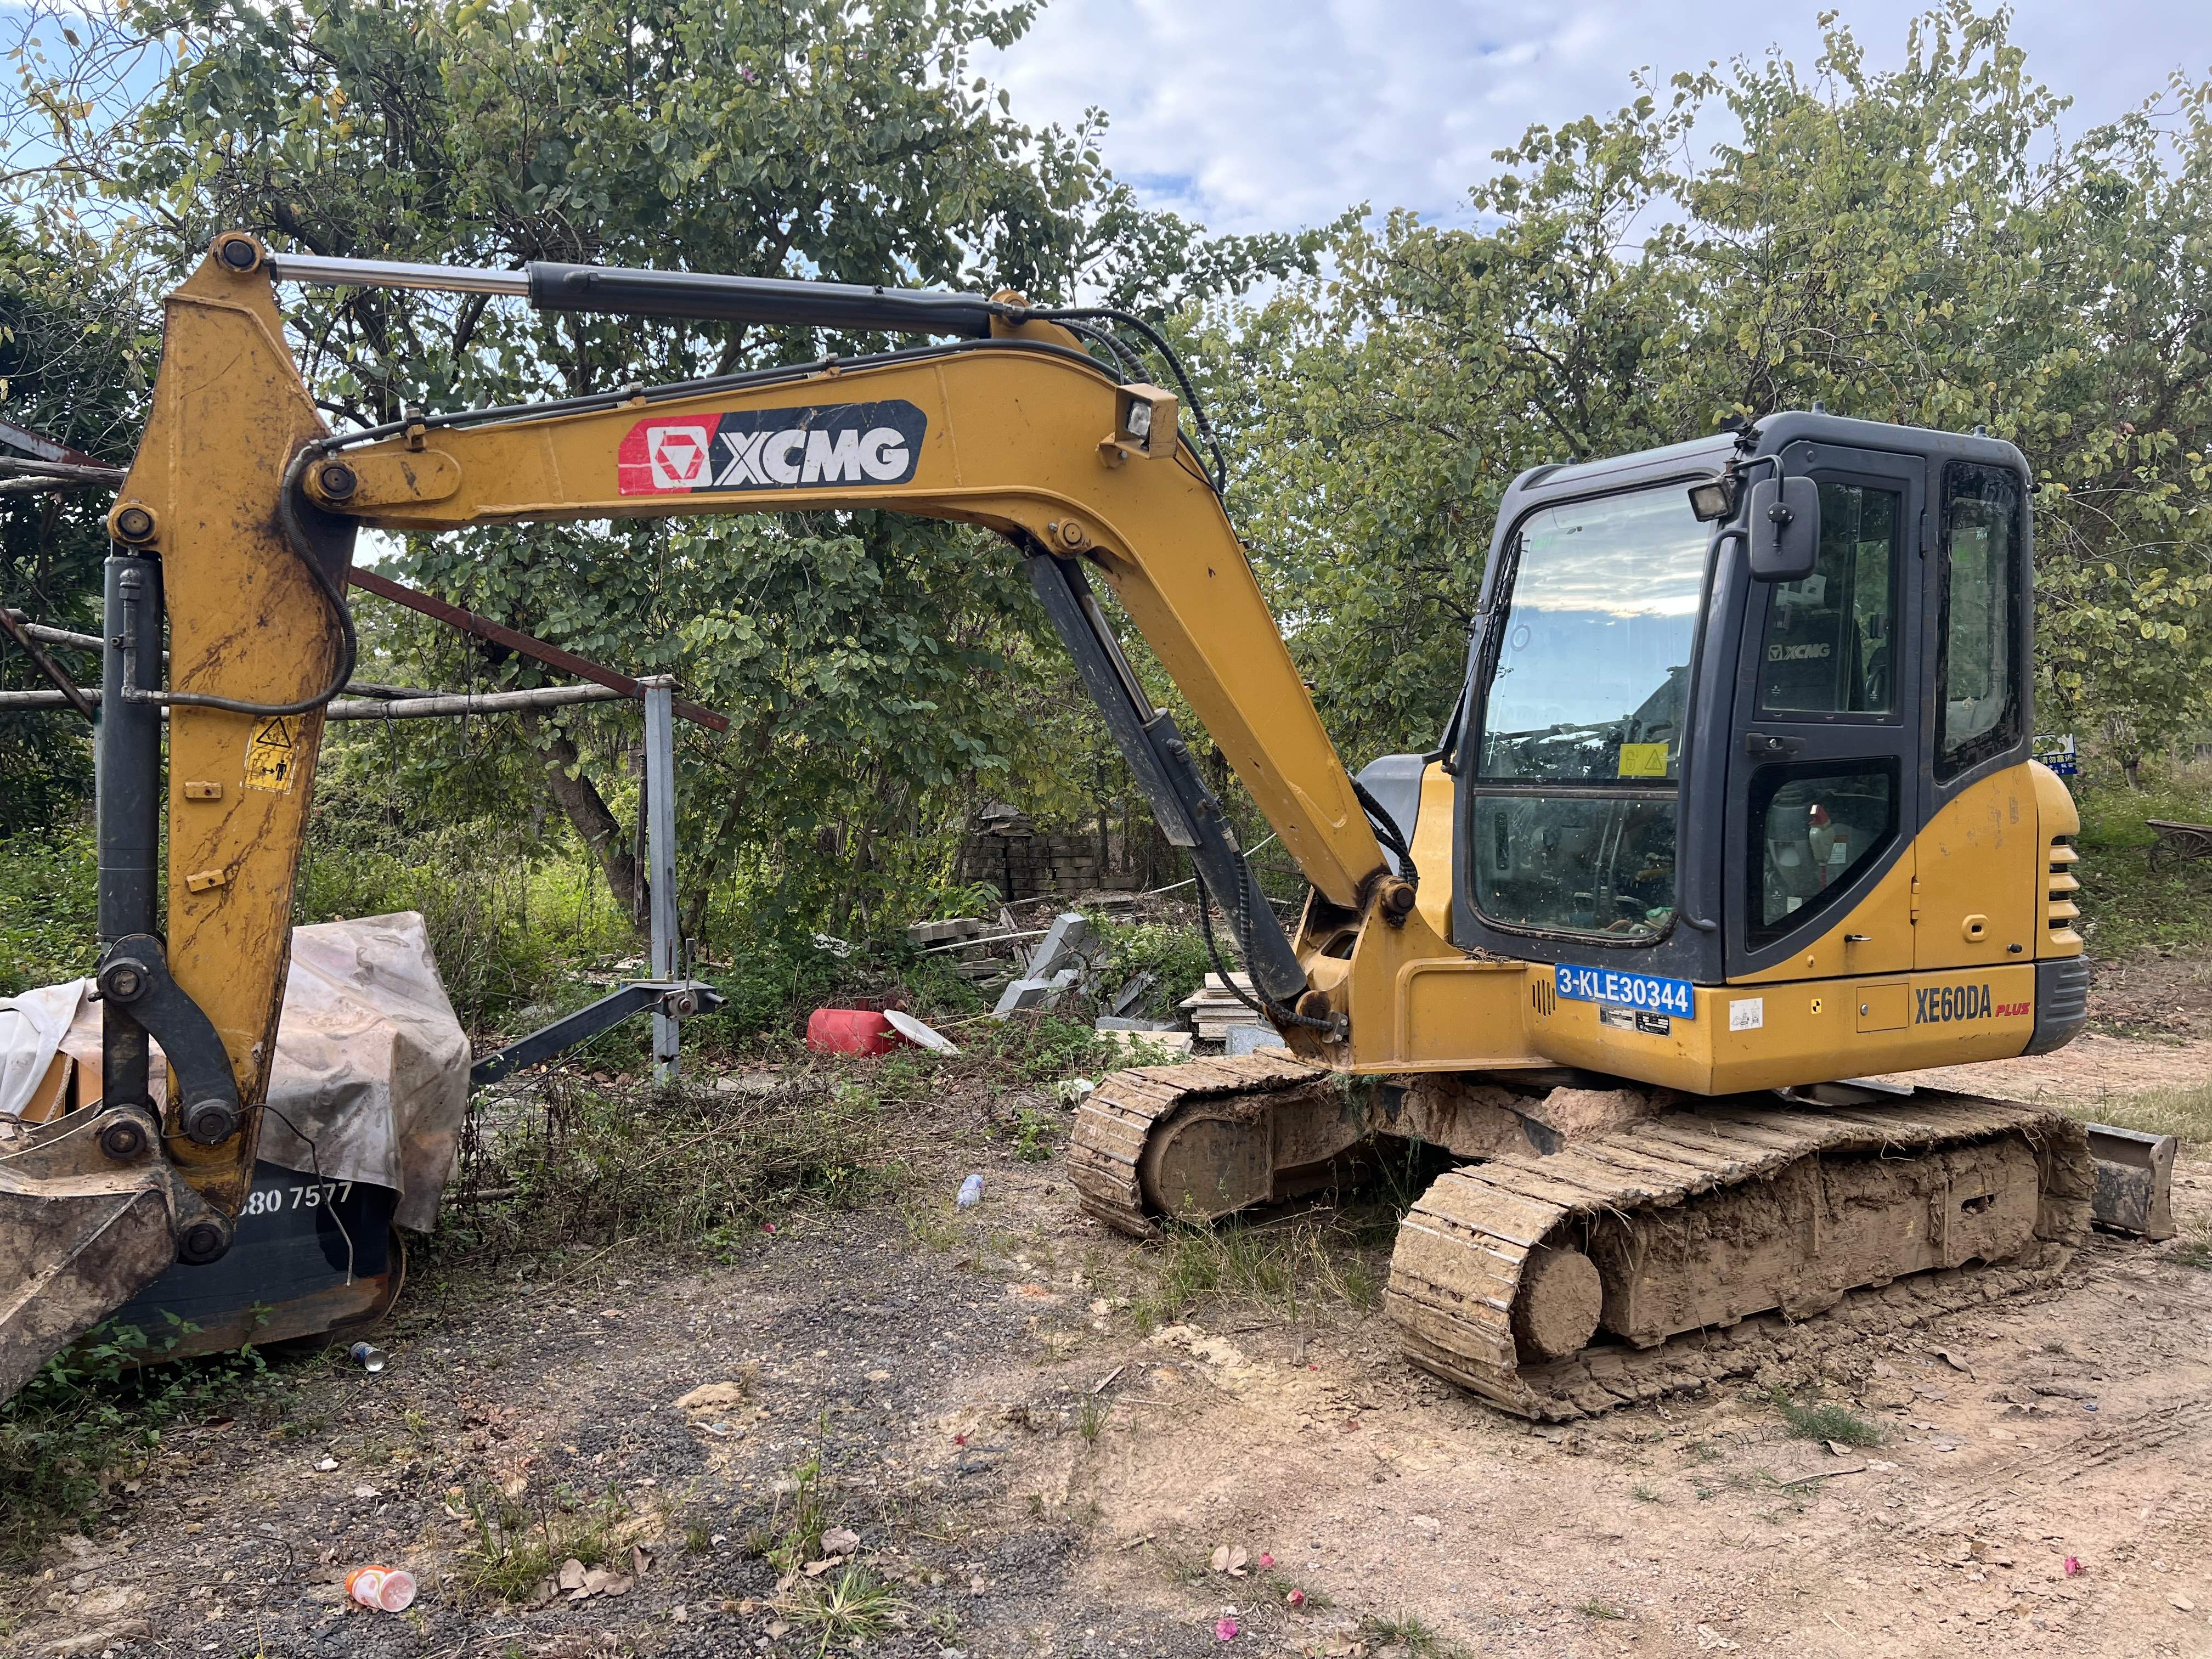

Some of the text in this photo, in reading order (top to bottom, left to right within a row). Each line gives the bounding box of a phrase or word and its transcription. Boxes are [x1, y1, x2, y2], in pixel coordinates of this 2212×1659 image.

[714, 427, 909, 486] XCMG
[1783, 642, 1831, 660] XCMG
[1559, 968, 1689, 1013] 3-KLE30344
[1915, 984, 2031, 1024] XE60DA PLUS
[239, 1181, 353, 1216] 80 7577
